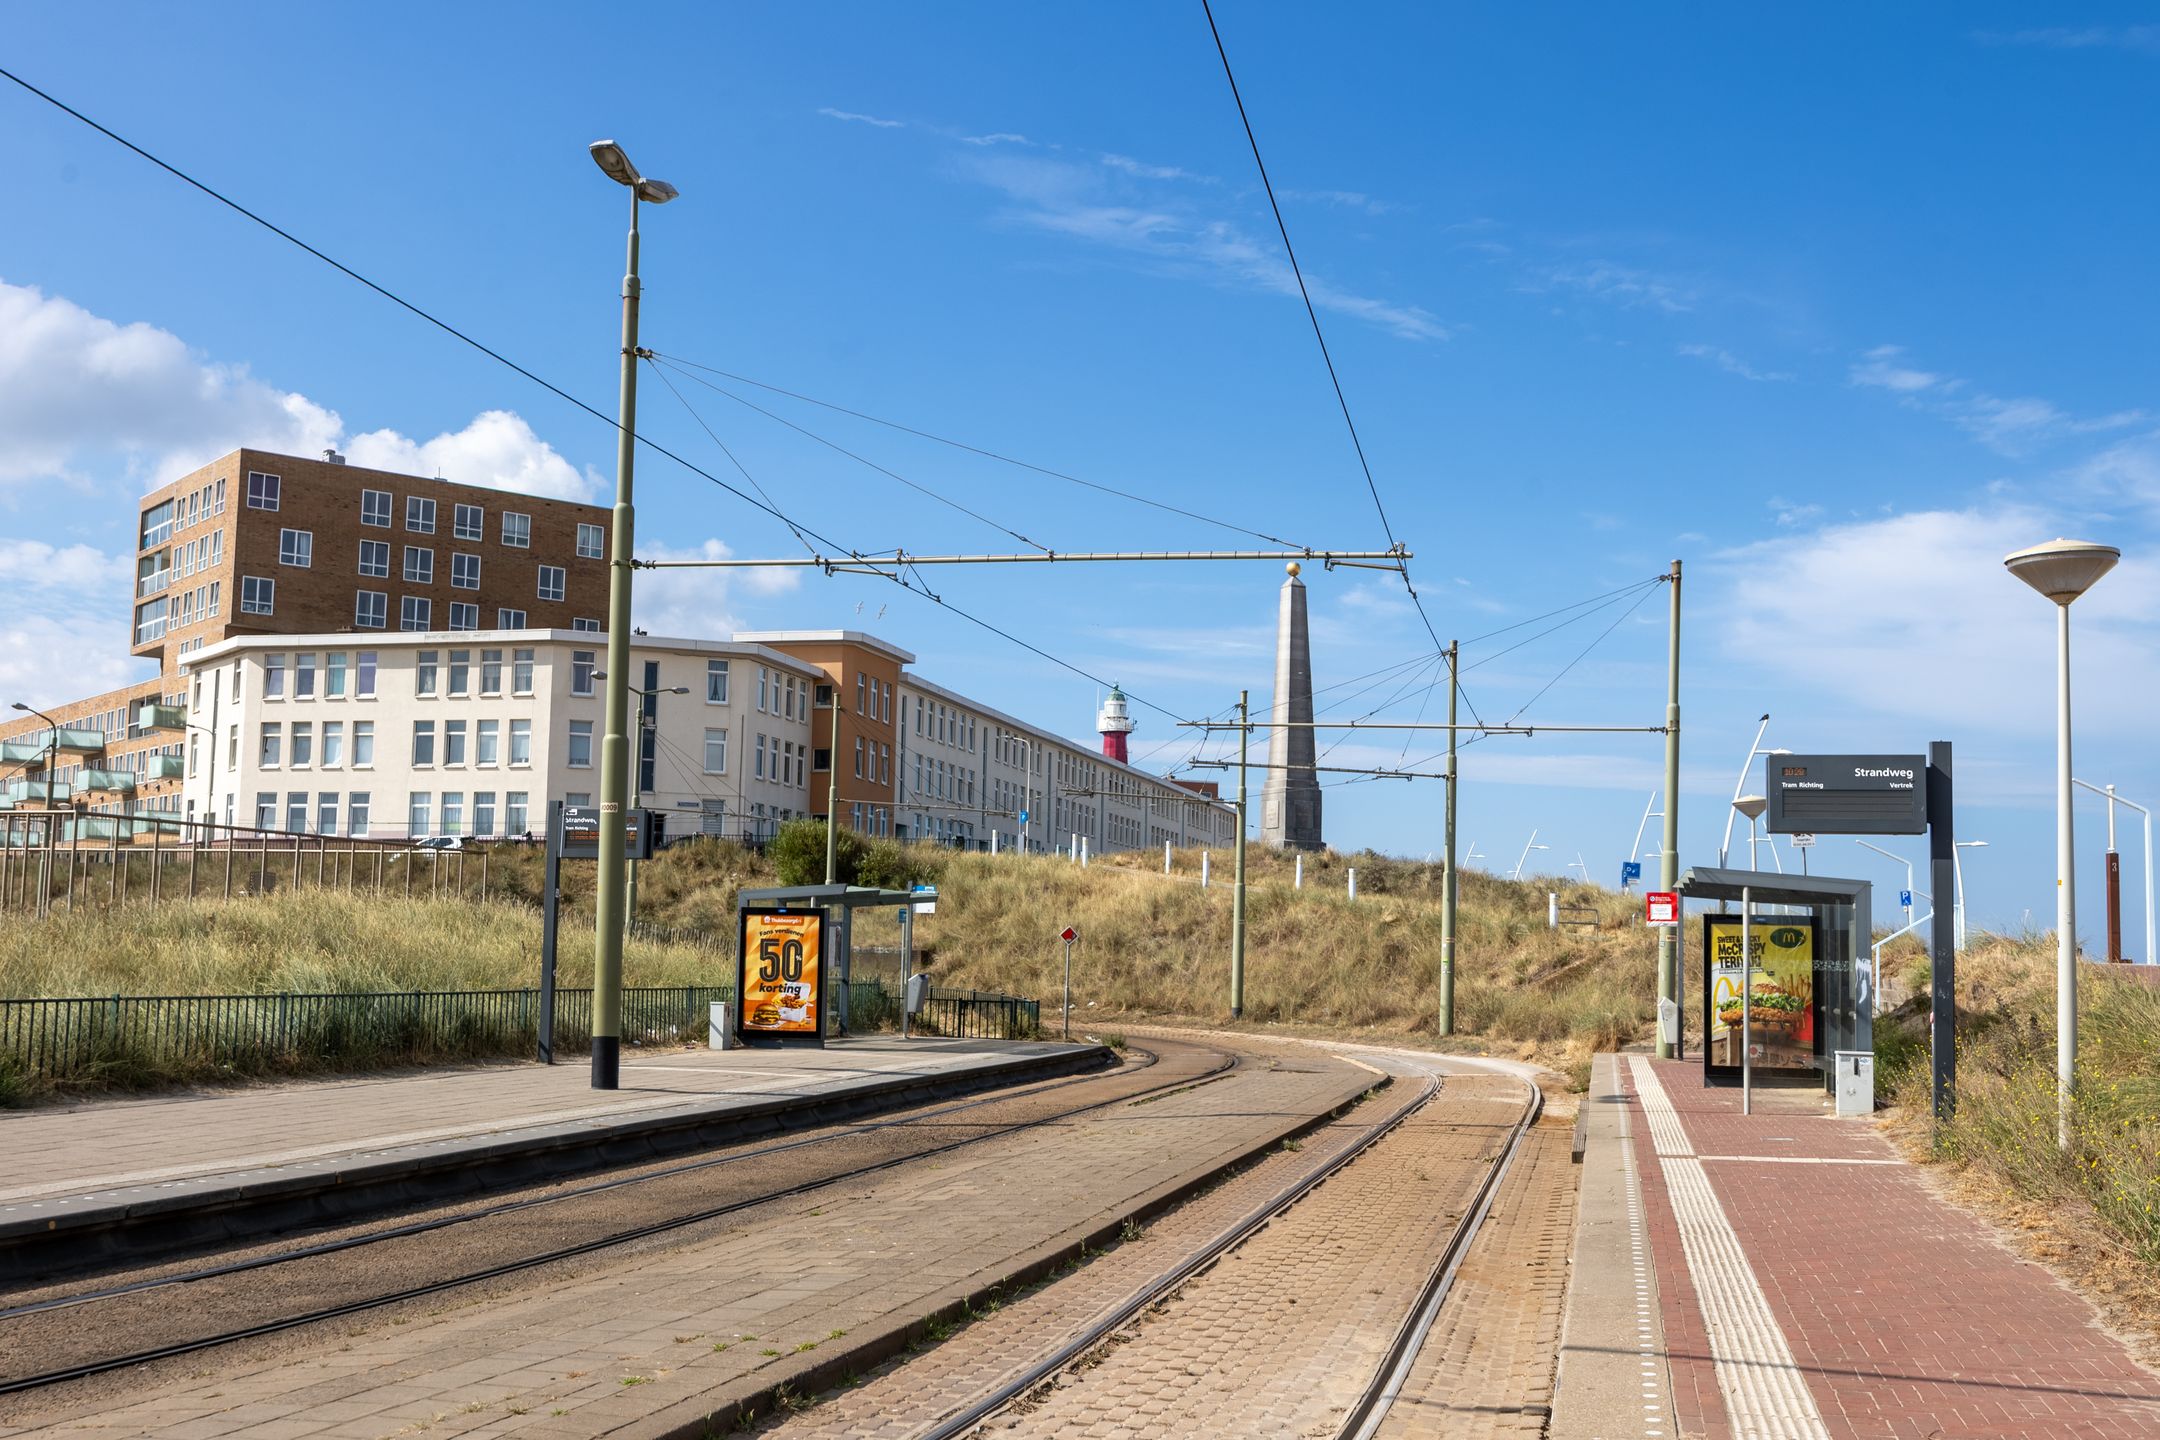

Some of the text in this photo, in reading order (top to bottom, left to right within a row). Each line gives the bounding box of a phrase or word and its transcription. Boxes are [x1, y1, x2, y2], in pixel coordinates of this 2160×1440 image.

[1854, 767, 1914, 779] Strandweg
[2112, 862, 2117, 872] 3
[1718, 942, 1766, 955] McCRSPY
[759, 983, 801, 995] korting
